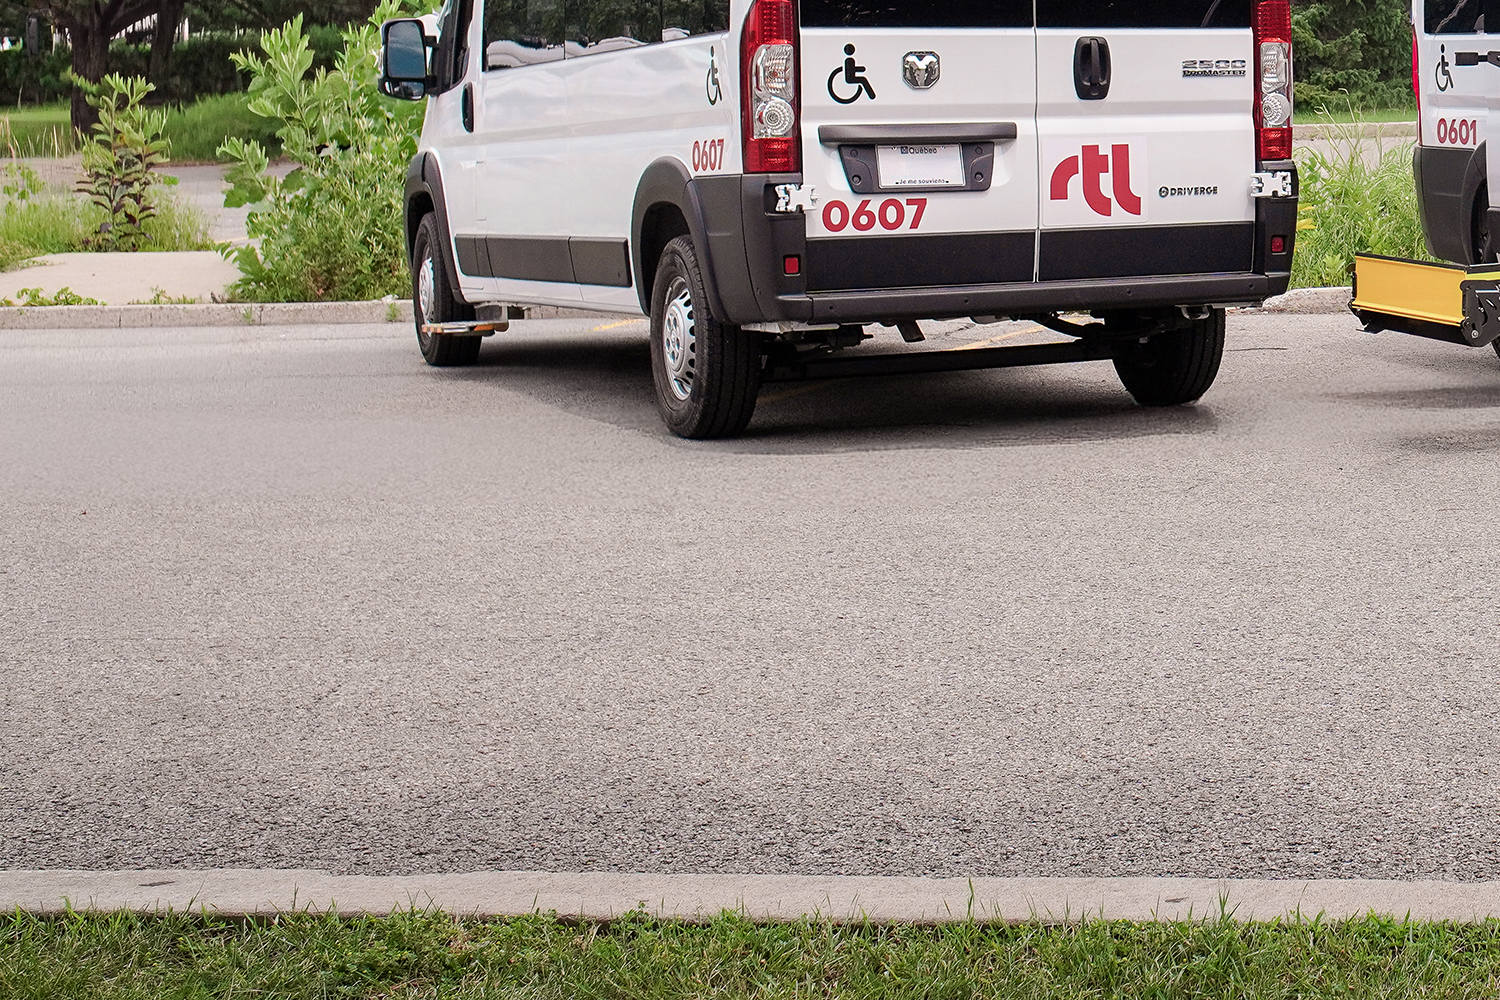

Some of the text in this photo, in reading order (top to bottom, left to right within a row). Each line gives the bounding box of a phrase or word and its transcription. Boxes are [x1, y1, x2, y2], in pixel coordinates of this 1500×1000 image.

[1182, 60, 1246, 69] 2500
[1437, 118, 1478, 146] 0601
[692, 138, 724, 172] 0607
[1050, 143, 1141, 217] rtl
[1170, 186, 1218, 196] DRIVERGE
[822, 198, 928, 232] 0607
